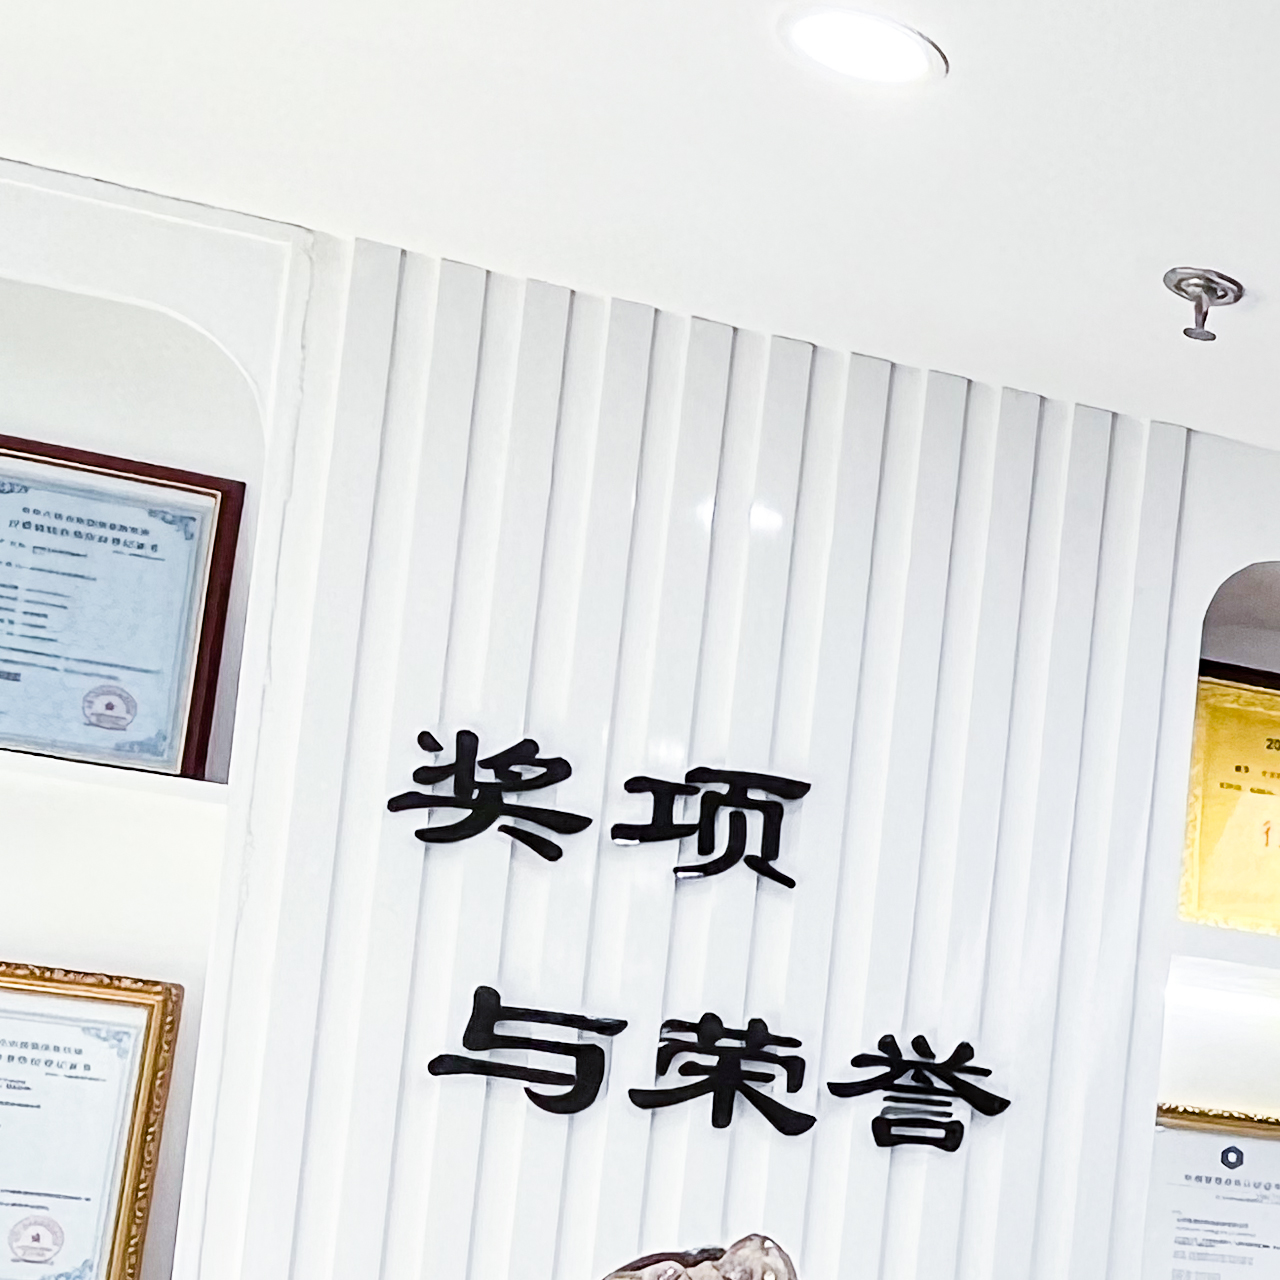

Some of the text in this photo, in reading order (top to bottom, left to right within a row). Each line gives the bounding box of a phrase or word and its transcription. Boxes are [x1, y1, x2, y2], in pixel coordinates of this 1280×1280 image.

[387, 730, 811, 889] 奖项
[428, 985, 1011, 1152] 与荣誉
